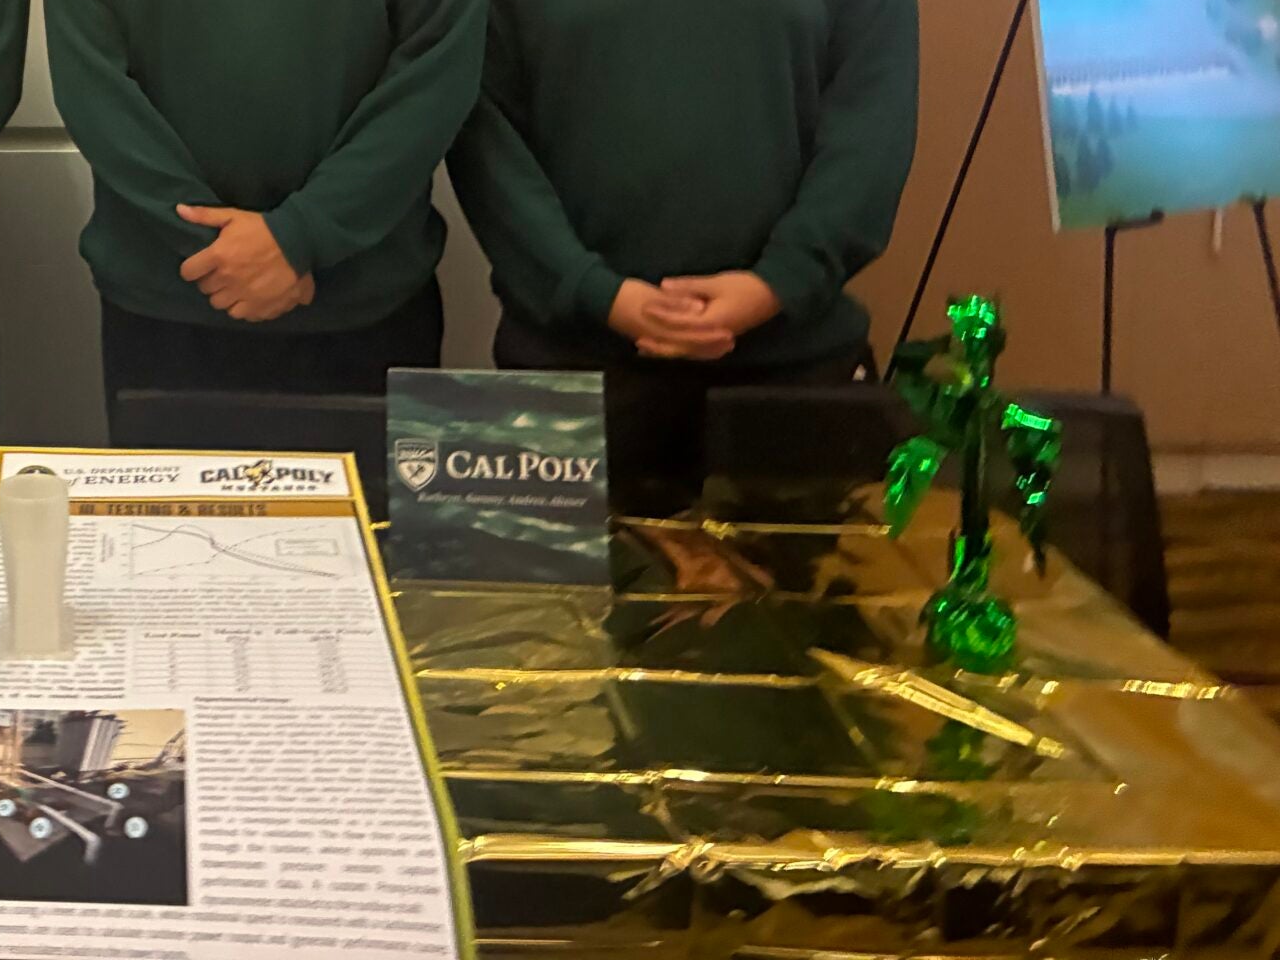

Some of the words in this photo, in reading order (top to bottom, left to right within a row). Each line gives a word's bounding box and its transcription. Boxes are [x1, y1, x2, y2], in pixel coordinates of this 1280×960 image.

[84, 474, 180, 485] ENERGY
[200, 467, 247, 484] CAL
[275, 467, 334, 483] POLY
[107, 503, 171, 517] TESTING
[197, 503, 266, 517] RESULTS
